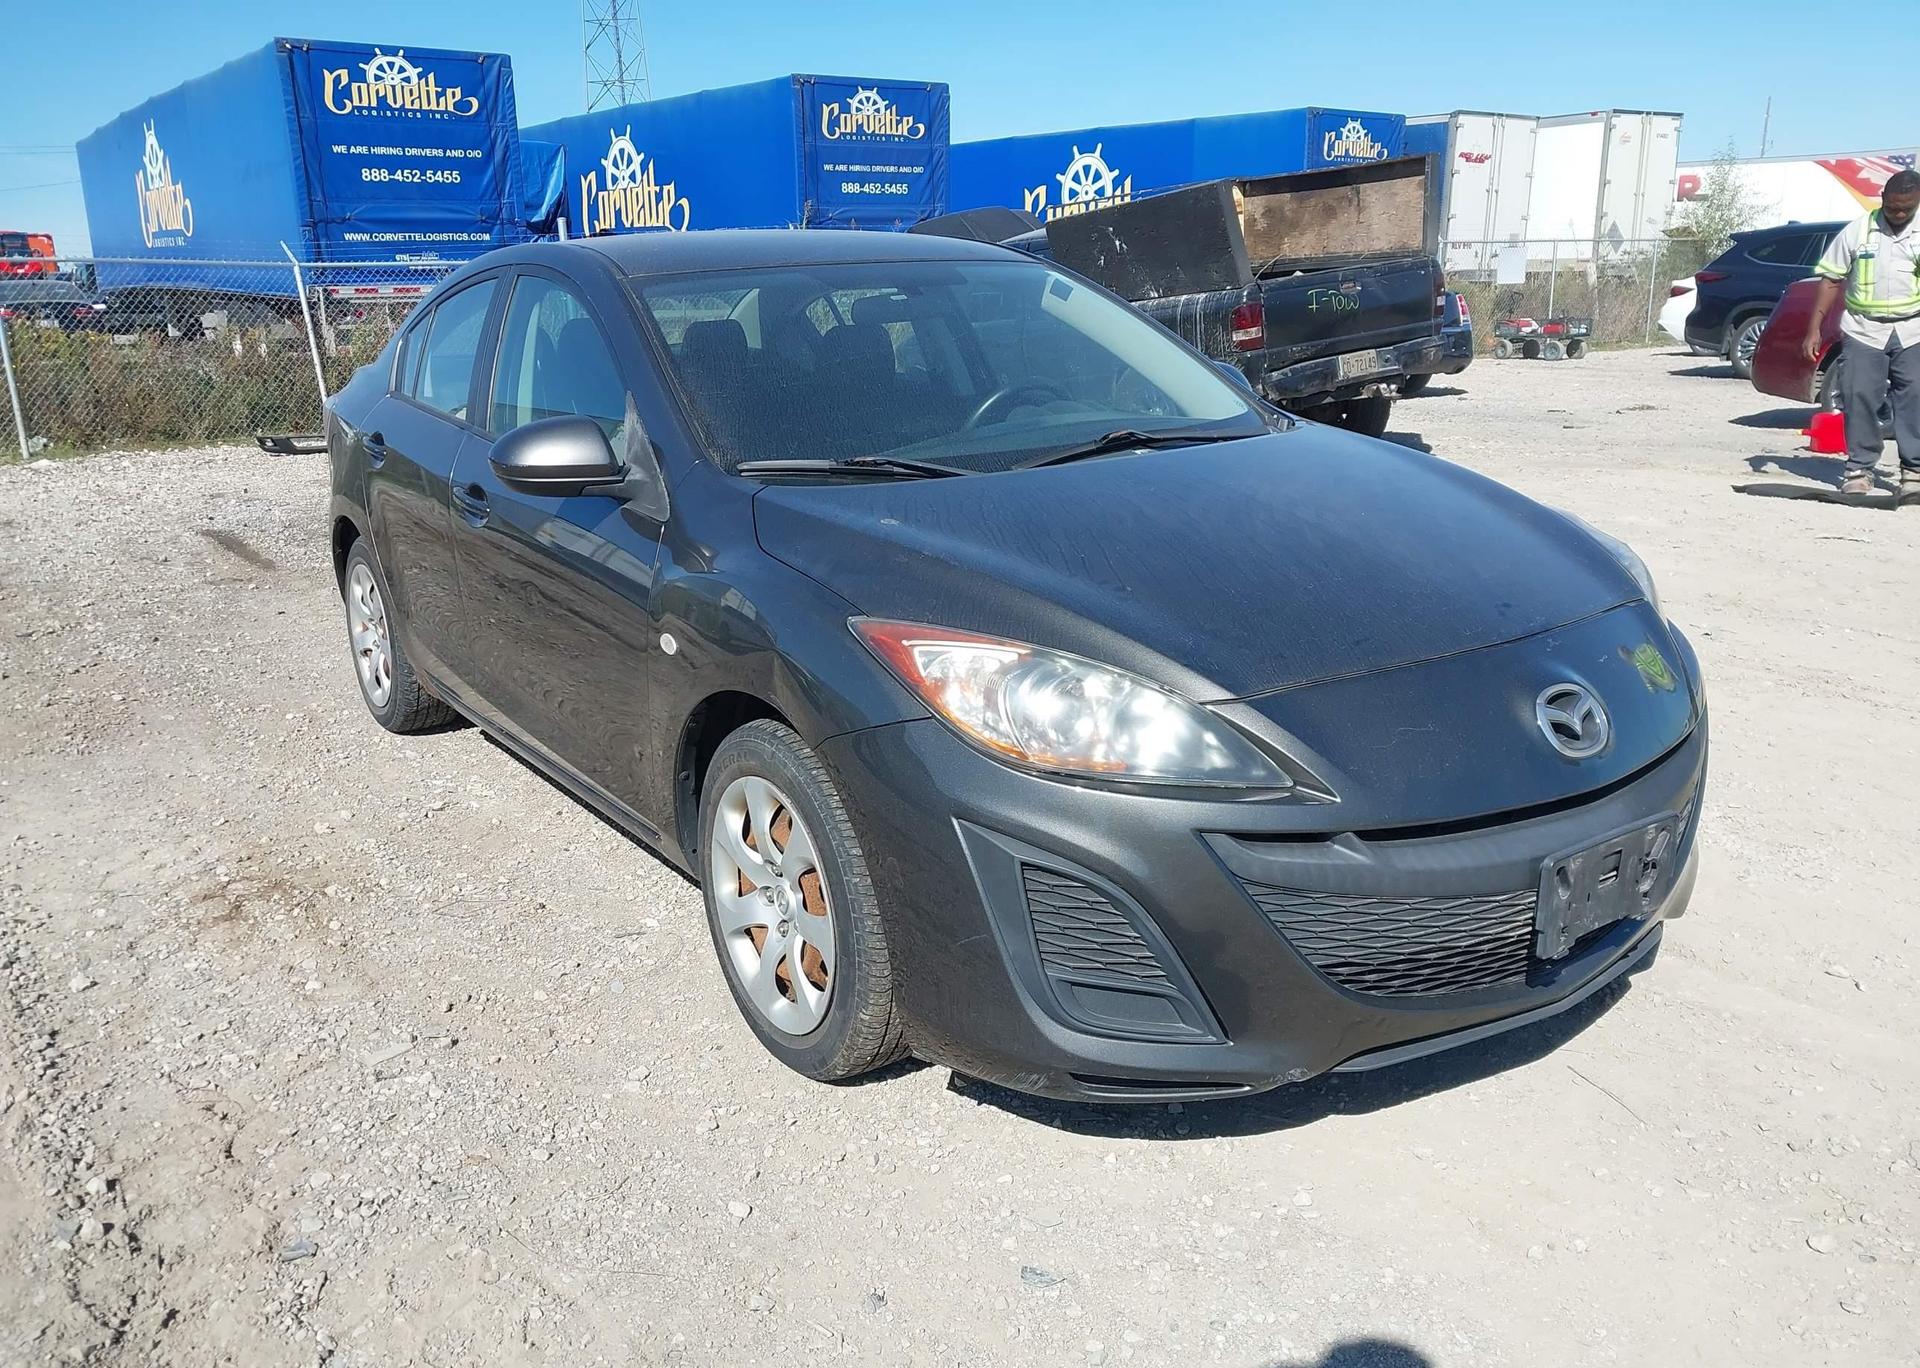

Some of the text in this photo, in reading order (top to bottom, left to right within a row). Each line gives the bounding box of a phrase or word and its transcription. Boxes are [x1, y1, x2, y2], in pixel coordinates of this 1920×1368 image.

[322, 71, 479, 116] Corvette
[354, 109, 456, 120] LOGISTICS INC.
[822, 103, 925, 139] Corvette
[332, 145, 348, 154] WE
[350, 145, 369, 155] ARE
[371, 146, 404, 156] HIRING
[405, 147, 444, 157] DRIVERS
[446, 149, 465, 158] AND
[1323, 132, 1388, 161] Corvette
[361, 168, 461, 183] 888-452-5455
[835, 164, 848, 172] ARE
[849, 164, 871, 173] HIRING
[871, 165, 898, 173] DRIVERS
[841, 182, 909, 195] 888-452-5455
[580, 158, 690, 236] Corvette
[344, 233, 490, 241] WWW.CORVETTELOGISTICS.COM
